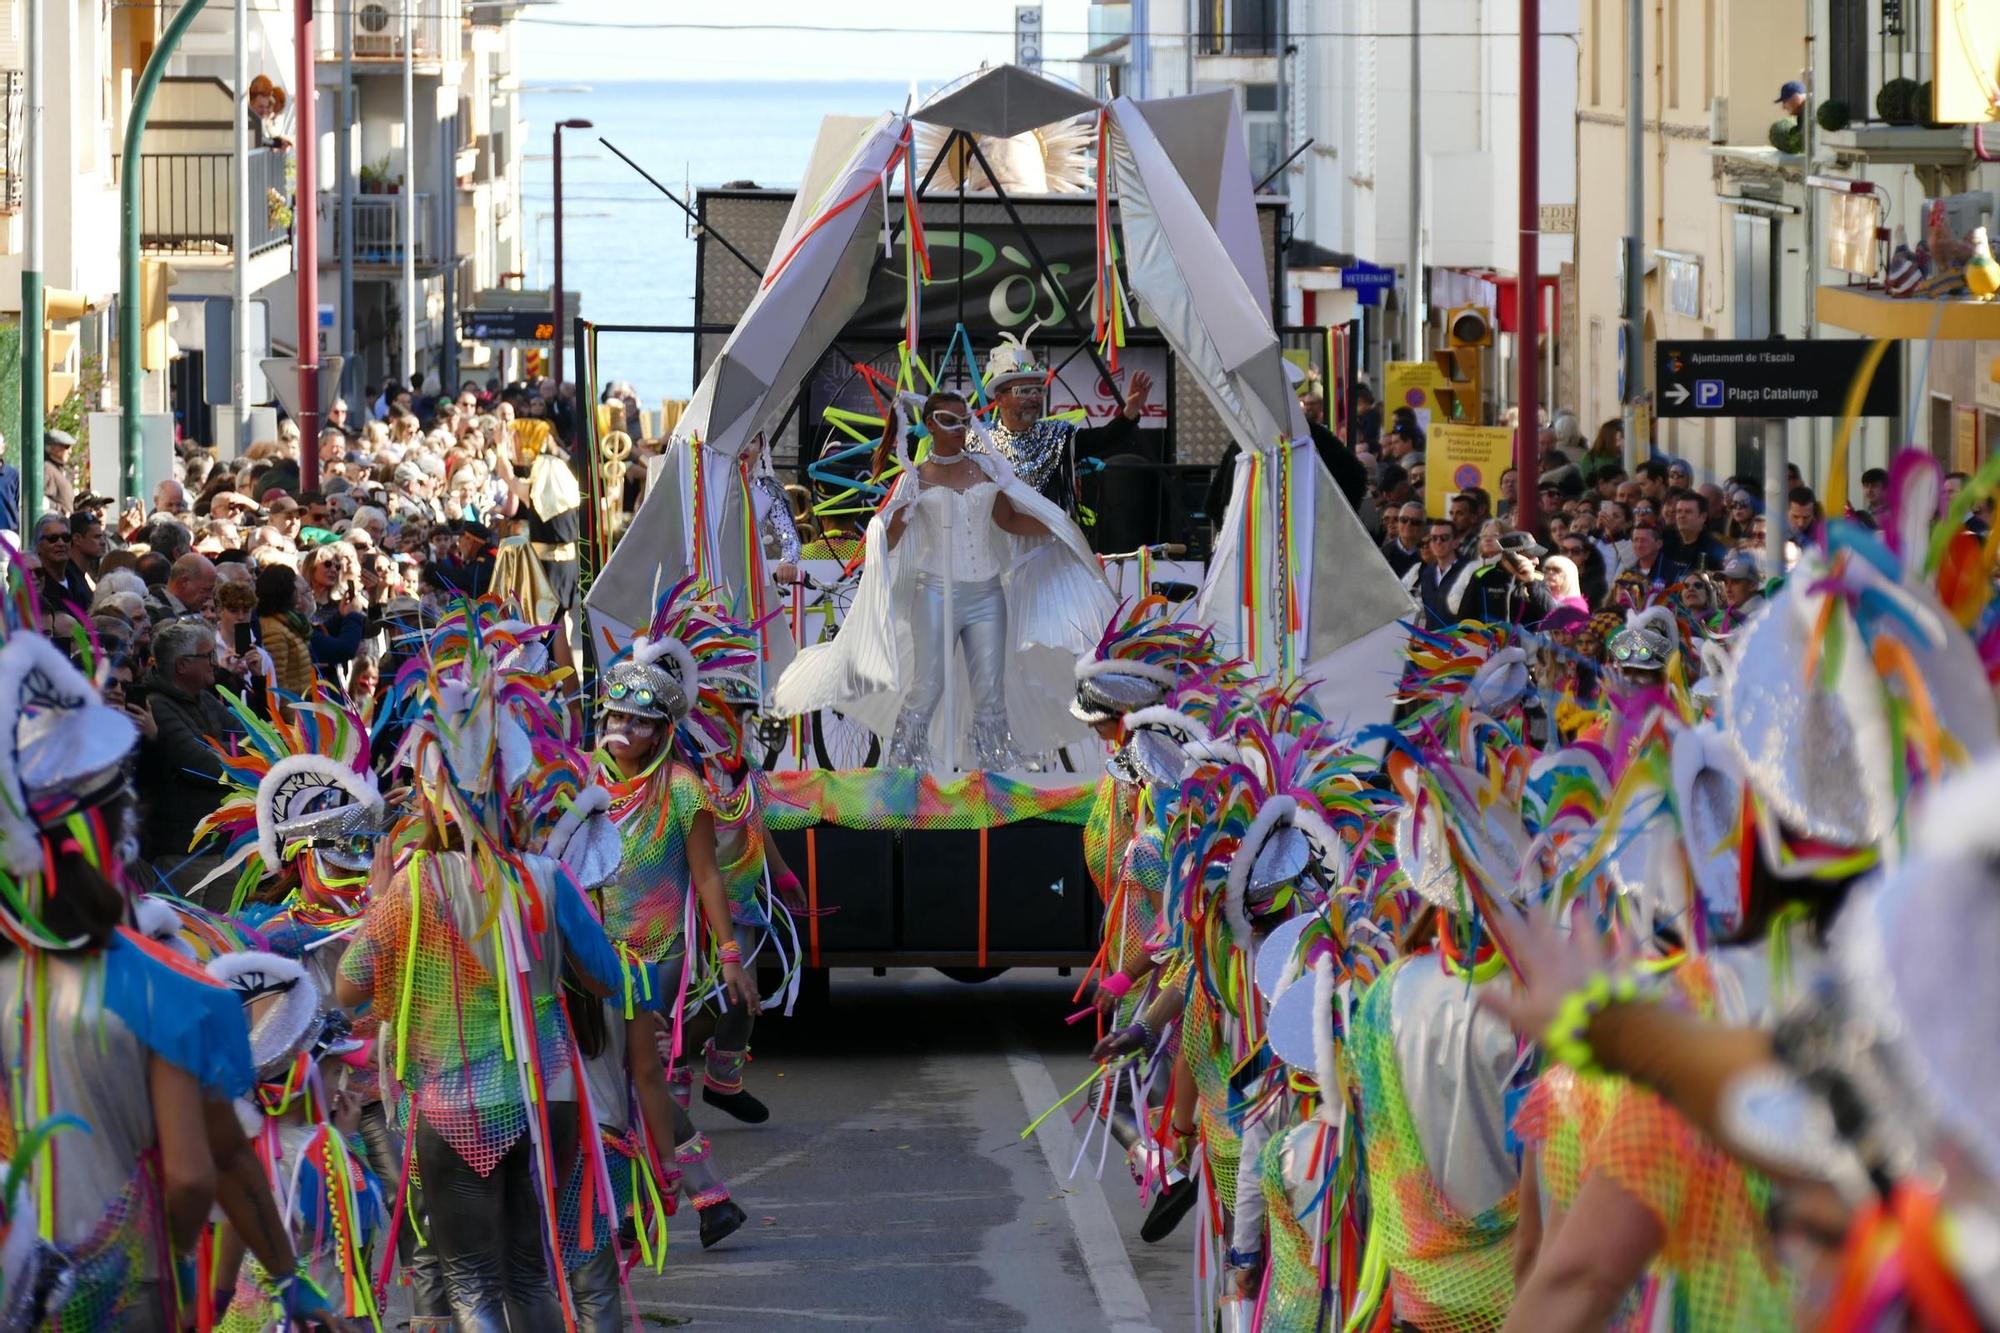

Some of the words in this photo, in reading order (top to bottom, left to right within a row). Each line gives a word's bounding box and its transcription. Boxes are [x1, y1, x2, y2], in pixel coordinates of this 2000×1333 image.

[1692, 353, 1744, 364] Ajuntament
[1746, 353, 1757, 362] de
[1760, 352, 1795, 362] l'Escala
[1701, 383, 1718, 404] P
[1728, 387, 1760, 402] Plaça
[1763, 387, 1818, 402] Catalunya
